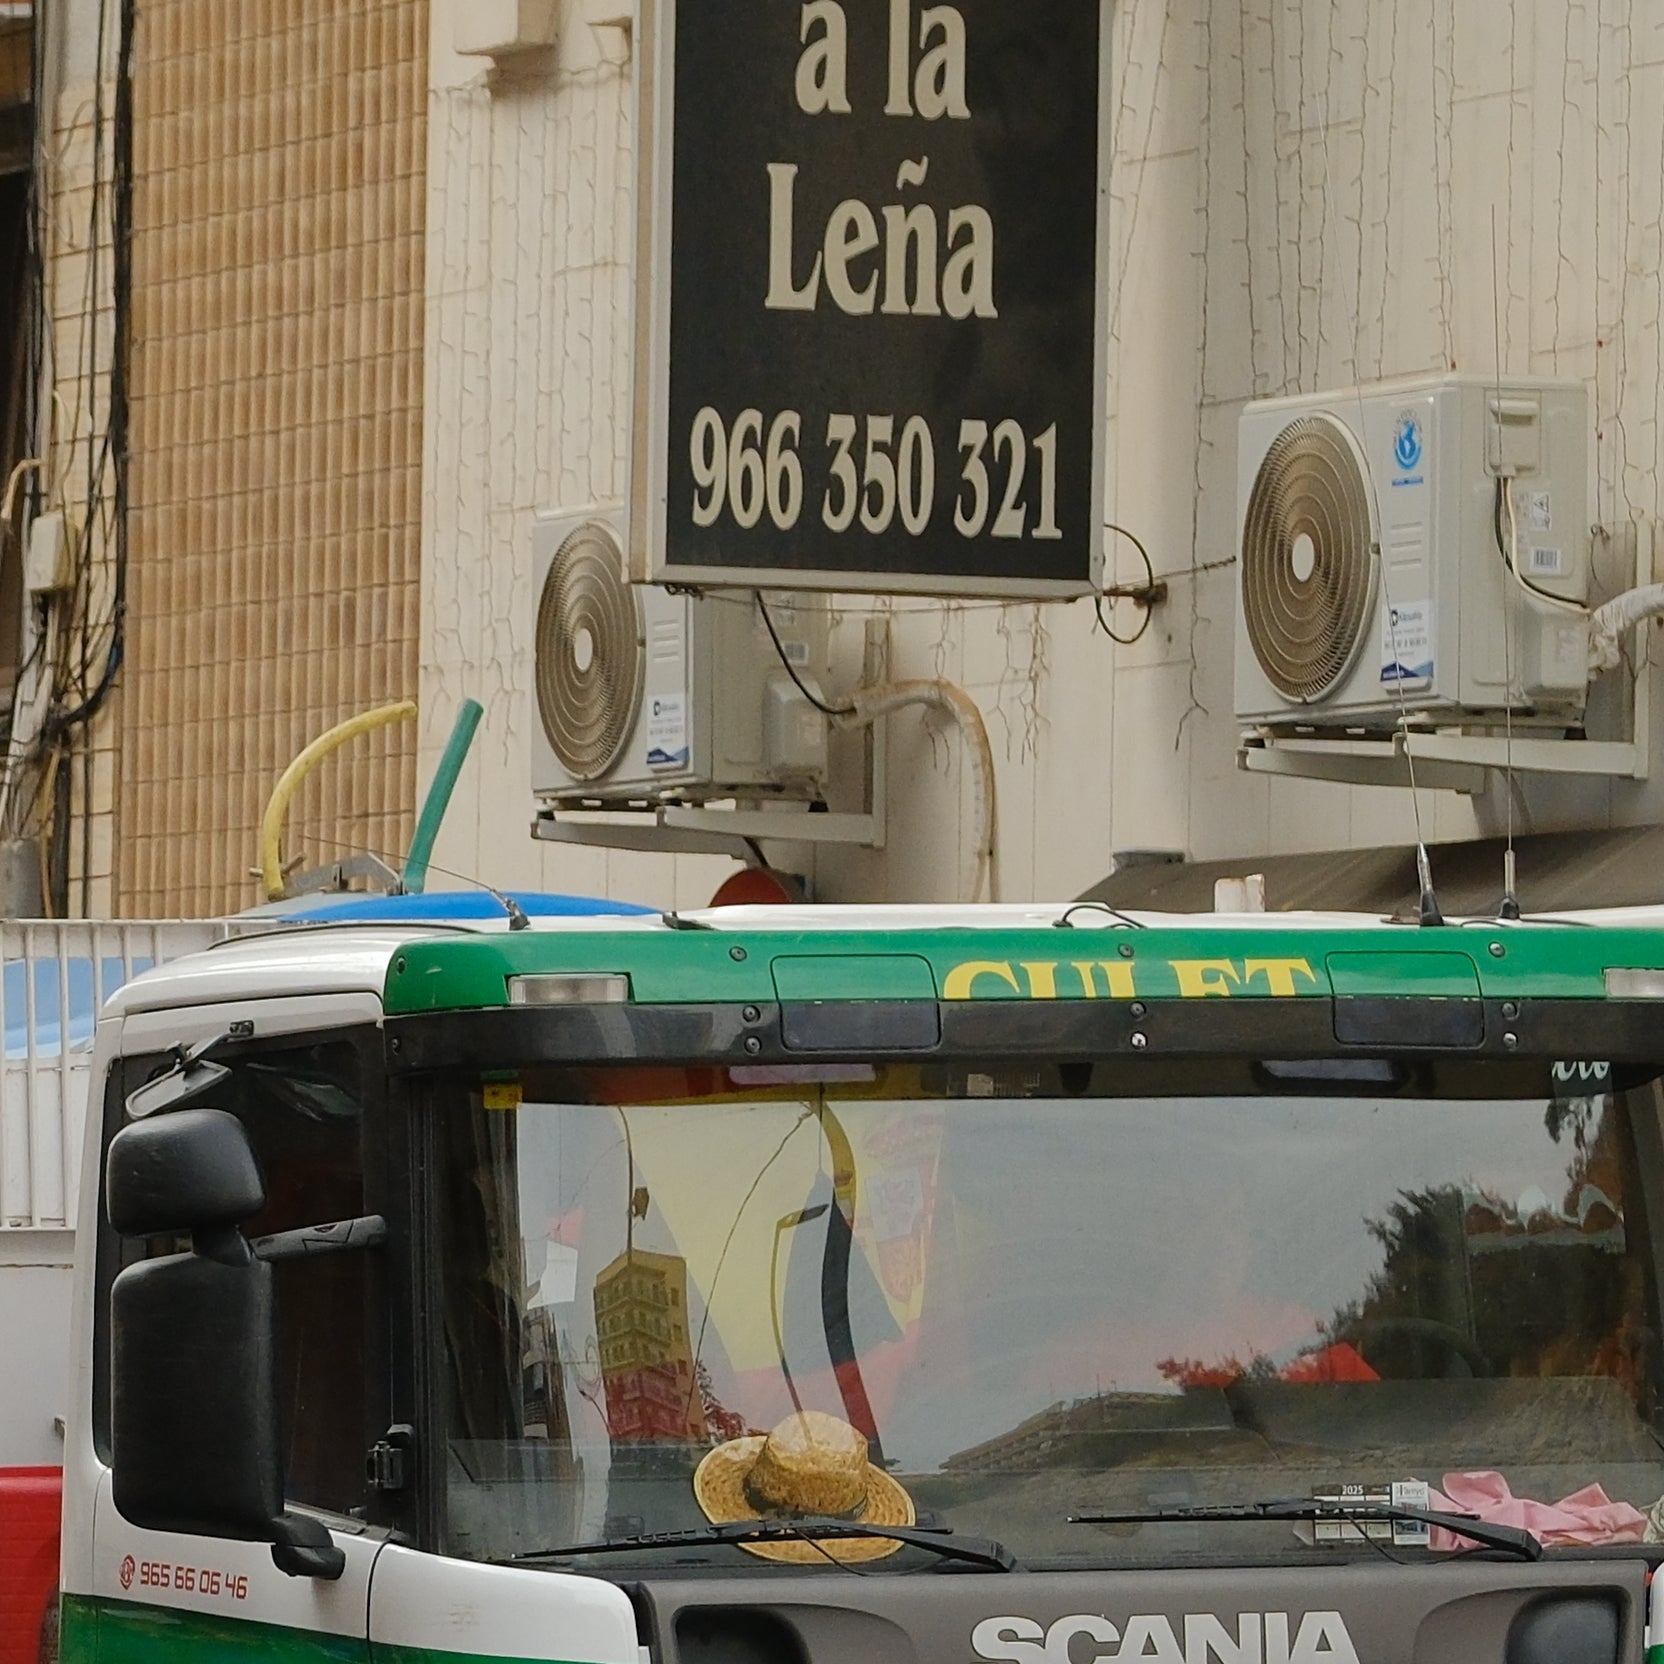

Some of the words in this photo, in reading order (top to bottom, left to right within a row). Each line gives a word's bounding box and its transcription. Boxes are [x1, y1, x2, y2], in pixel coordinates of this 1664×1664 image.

[795, 0, 852, 115] a
[884, 0, 971, 121] la
[765, 156, 998, 321] Leña
[690, 406, 803, 530] 966
[822, 413, 935, 535] 350
[954, 418, 1062, 539] 321
[1342, 1484, 1364, 1495] 2025
[140, 1562, 171, 1587] 965
[174, 1566, 196, 1591] 66
[199, 1570, 221, 1595] 06
[225, 1573, 249, 1599] 46
